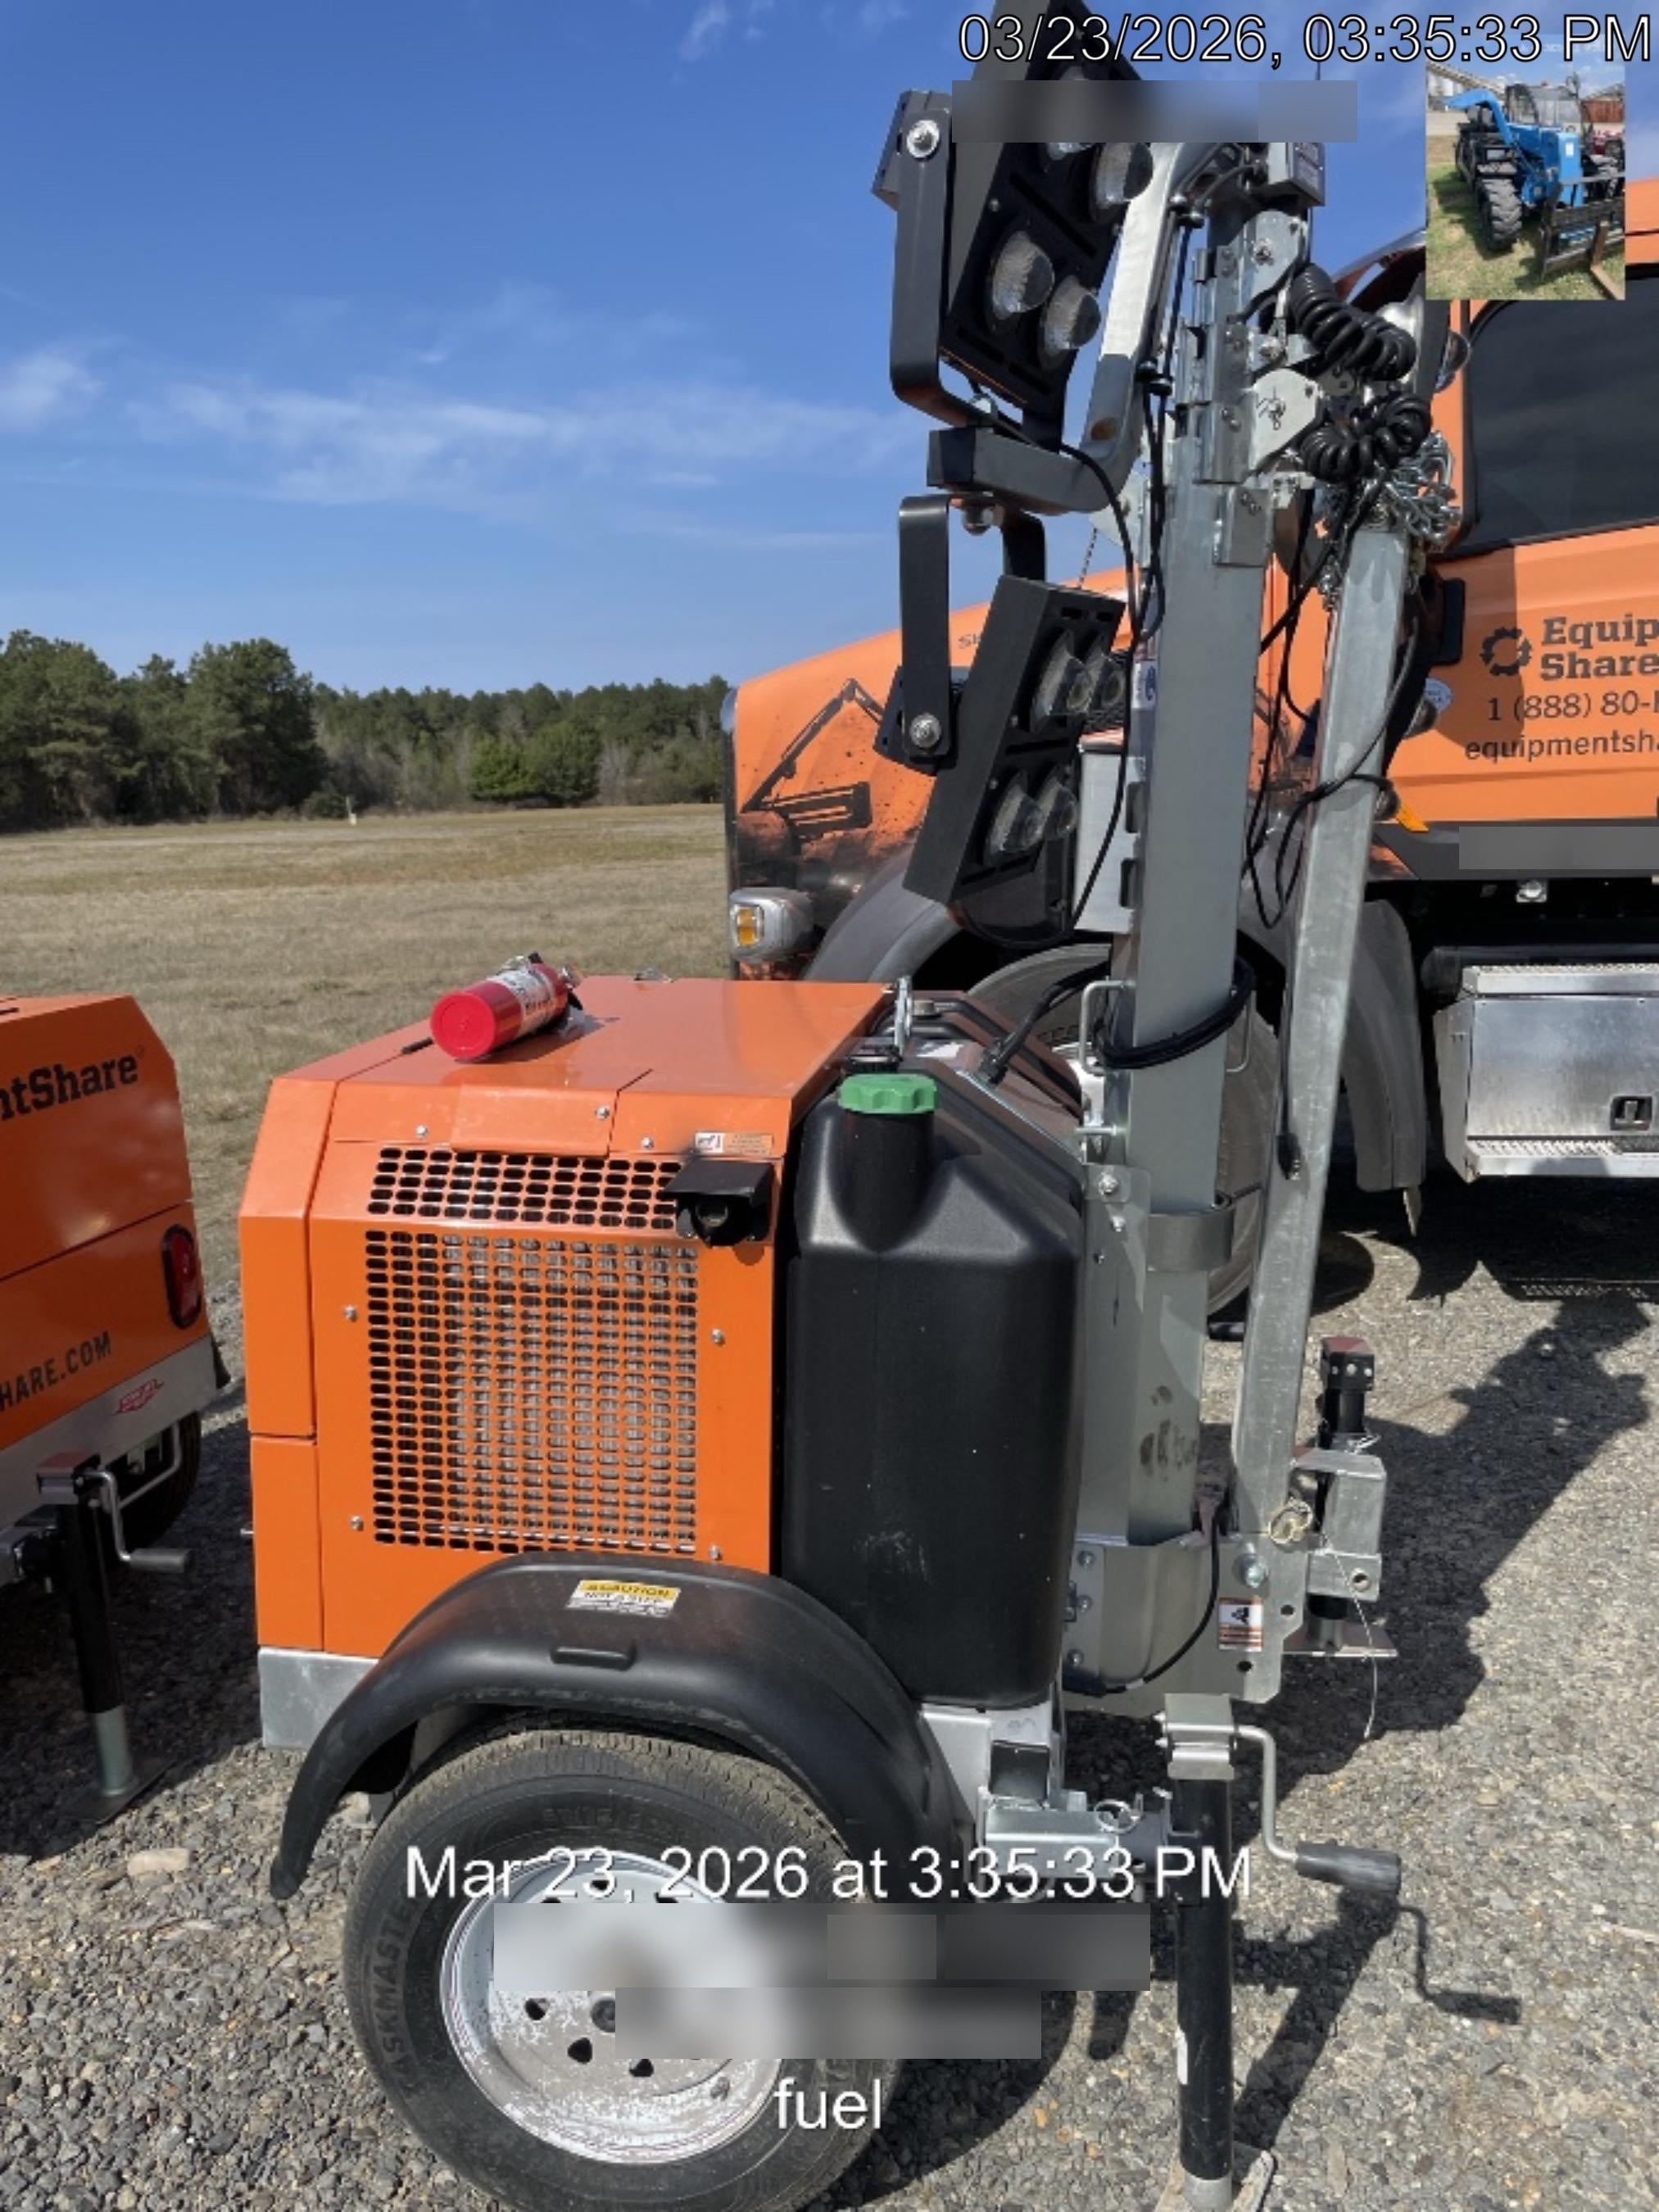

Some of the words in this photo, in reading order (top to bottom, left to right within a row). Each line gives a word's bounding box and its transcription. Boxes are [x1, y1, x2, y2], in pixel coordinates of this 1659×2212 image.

[1542, 614, 1659, 649] Equip
[1540, 652, 1659, 681] Share
[1488, 698, 1501, 721] 1
[1514, 693, 1591, 721] (888)
[1465, 730, 1659, 764] equipmentsh
